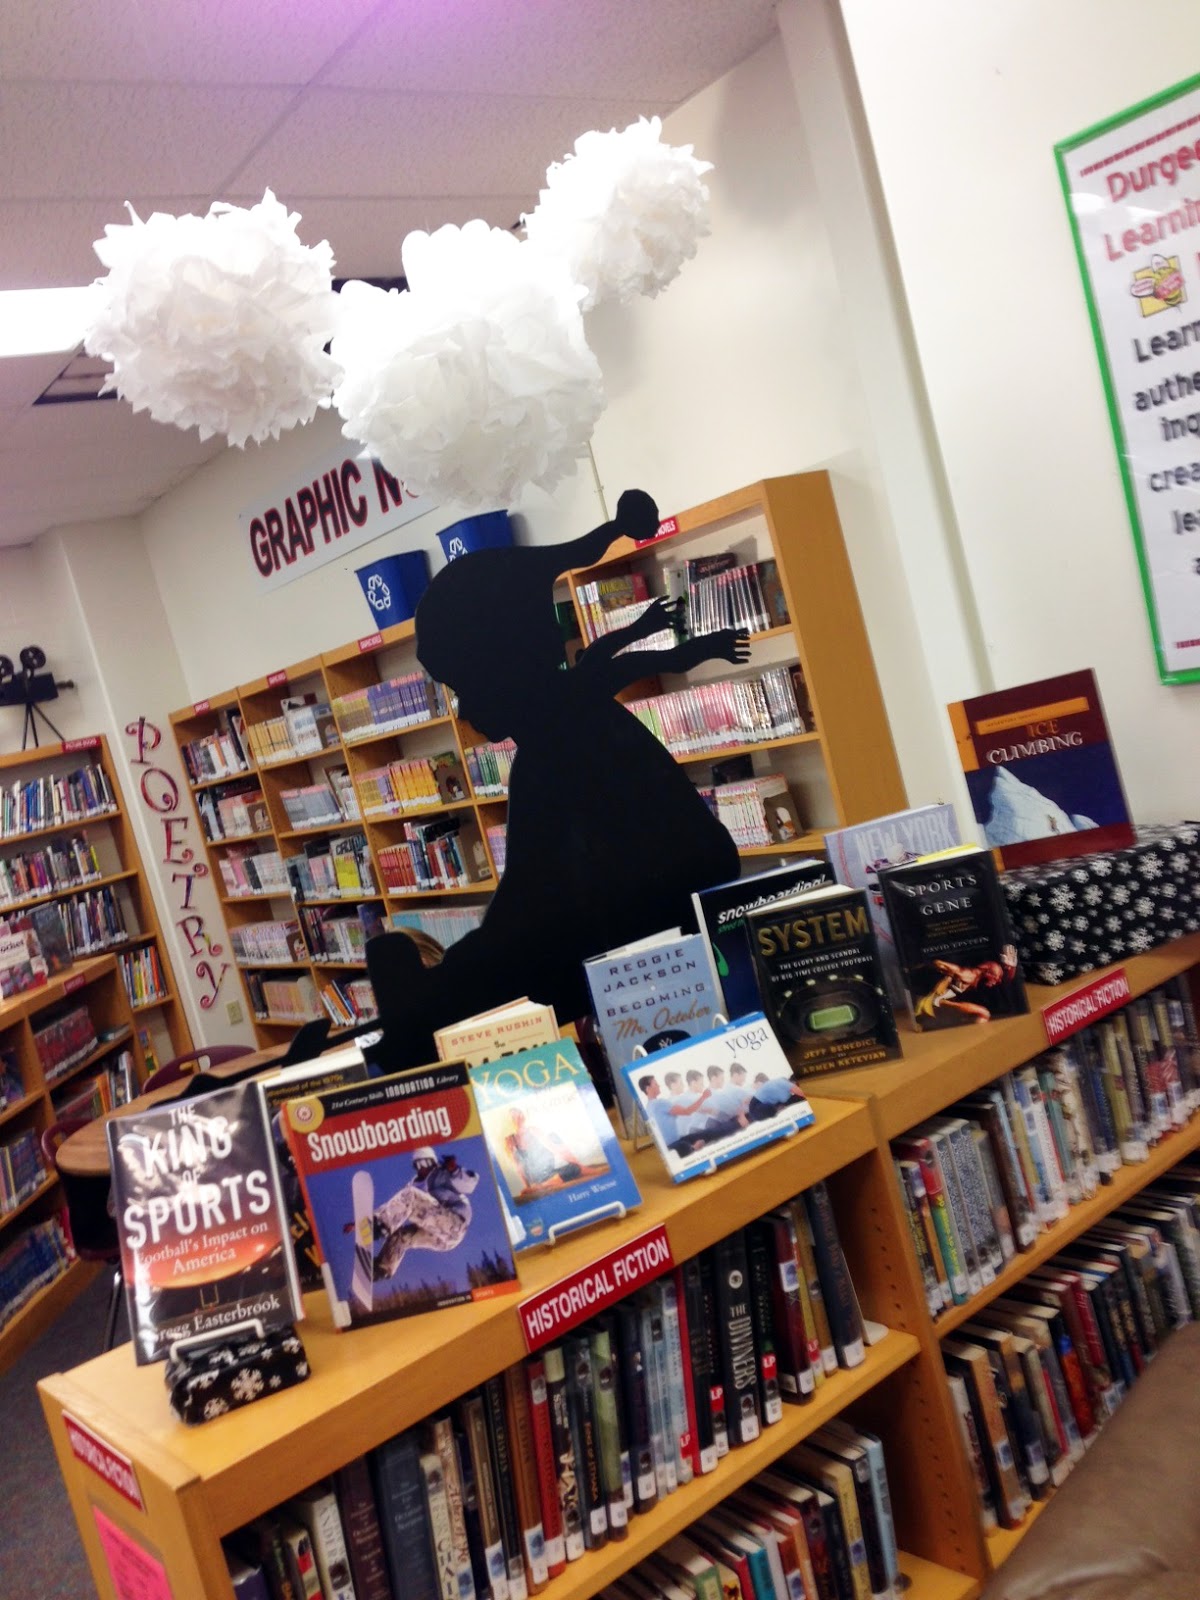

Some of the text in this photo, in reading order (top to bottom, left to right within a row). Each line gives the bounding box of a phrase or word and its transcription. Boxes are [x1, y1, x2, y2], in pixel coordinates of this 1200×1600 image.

[250, 459, 368, 578] GRAPHIC
[1026, 719, 1061, 737] ICE
[986, 731, 1084, 764] CLIMBING
[125, 716, 231, 1010] POETRY
[904, 874, 977, 897] SPORTS
[921, 897, 973, 916] GENE
[758, 906, 870, 957] SYSTEM
[609, 949, 684, 976] REGGIE
[780, 947, 861, 971] THE GLORY AND SCANDAL
[813, 963, 840, 973] COLLEGE
[841, 955, 873, 968] FOOTBALL
[604, 961, 696, 993] JACKSON
[606, 983, 705, 1017] BECOMING
[1046, 976, 1130, 1036] HISTORICAL FICTION
[451, 1016, 543, 1046] STEVE RUSHIN
[613, 999, 711, 1041] Mr. October
[725, 1025, 770, 1058] yoga
[803, 1038, 877, 1059] JEFF BENEDICT
[470, 1053, 580, 1105] YOGA
[803, 1061, 836, 1074] ARMEN
[385, 1077, 436, 1099] INNOVATION
[436, 1074, 459, 1087] Library
[168, 1103, 196, 1126] THE
[140, 1115, 233, 1178] KING
[307, 1106, 452, 1162] Snowboarding
[123, 1170, 271, 1250] SPORTS
[202, 1227, 248, 1249] Impact
[251, 1222, 268, 1234] on
[172, 1247, 237, 1276] America
[526, 1236, 670, 1339] HISTORICAL FICTION
[194, 1294, 281, 1331] Easterbrook
[729, 1302, 748, 1317] THE
[762, 1355, 775, 1368] LP
[710, 1386, 723, 1400] LP
[680, 1433, 690, 1447] LP
